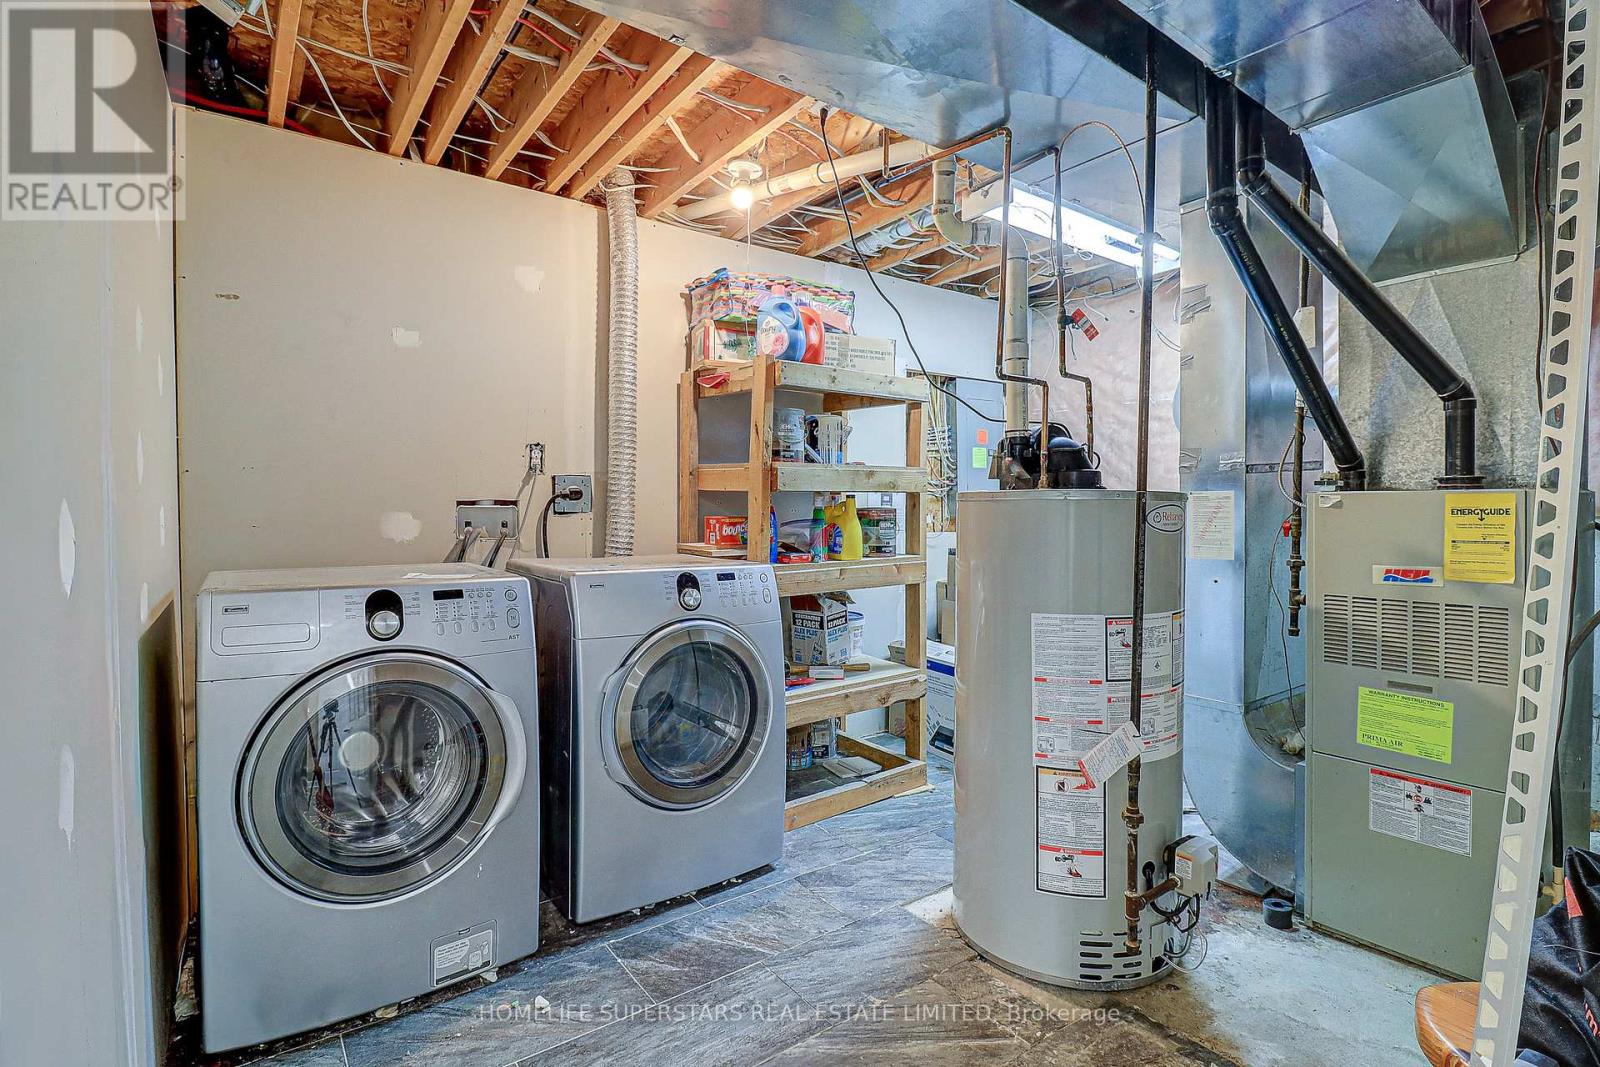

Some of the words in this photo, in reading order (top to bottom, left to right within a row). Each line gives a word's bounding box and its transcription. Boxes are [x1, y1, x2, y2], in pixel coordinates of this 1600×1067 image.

[803, 620, 820, 629] PACK
[1368, 690, 1400, 698] WARRANTY
[1401, 696, 1444, 707] INSTRUCTIONS
[1362, 733, 1387, 744] PRIMA
